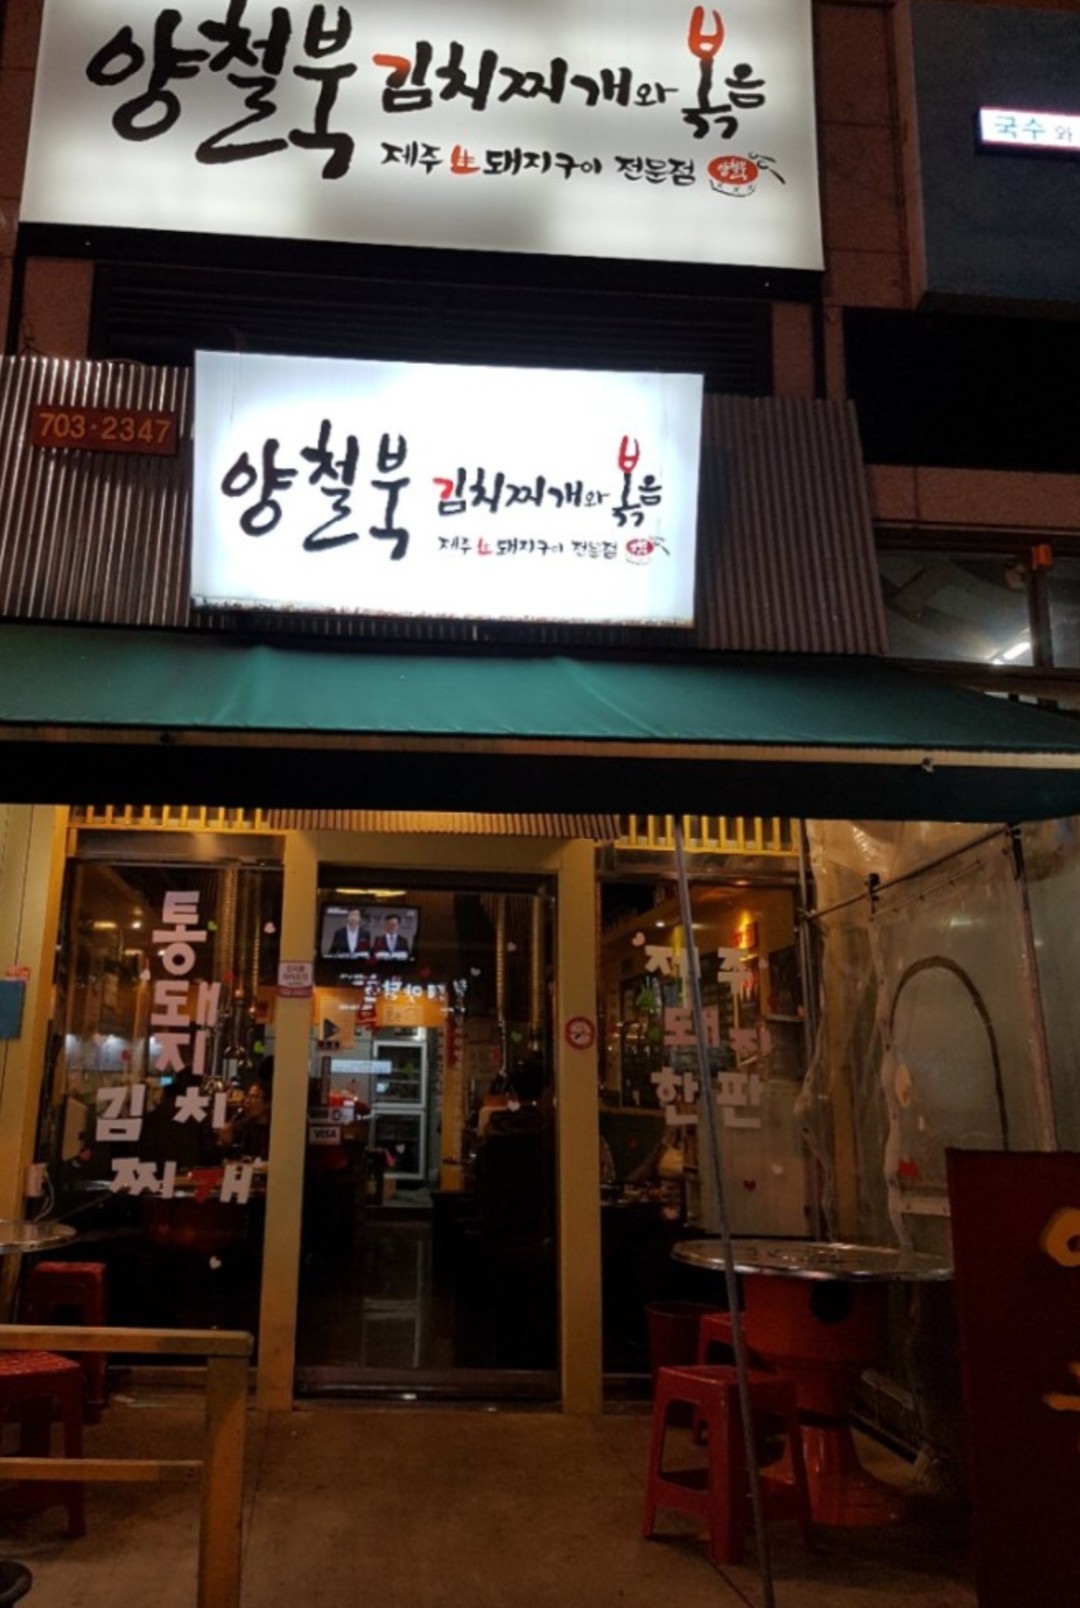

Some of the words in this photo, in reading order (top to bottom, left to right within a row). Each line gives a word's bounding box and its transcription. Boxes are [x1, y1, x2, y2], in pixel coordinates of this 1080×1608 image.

[86, 0, 358, 179] 양철북
[680, 5, 766, 139] 볶음
[380, 140, 443, 175] 제주
[614, 155, 696, 187] 전문점
[221, 419, 410, 560] 양철북
[611, 434, 663, 528] 볶음
[438, 536, 472, 555] 제주
